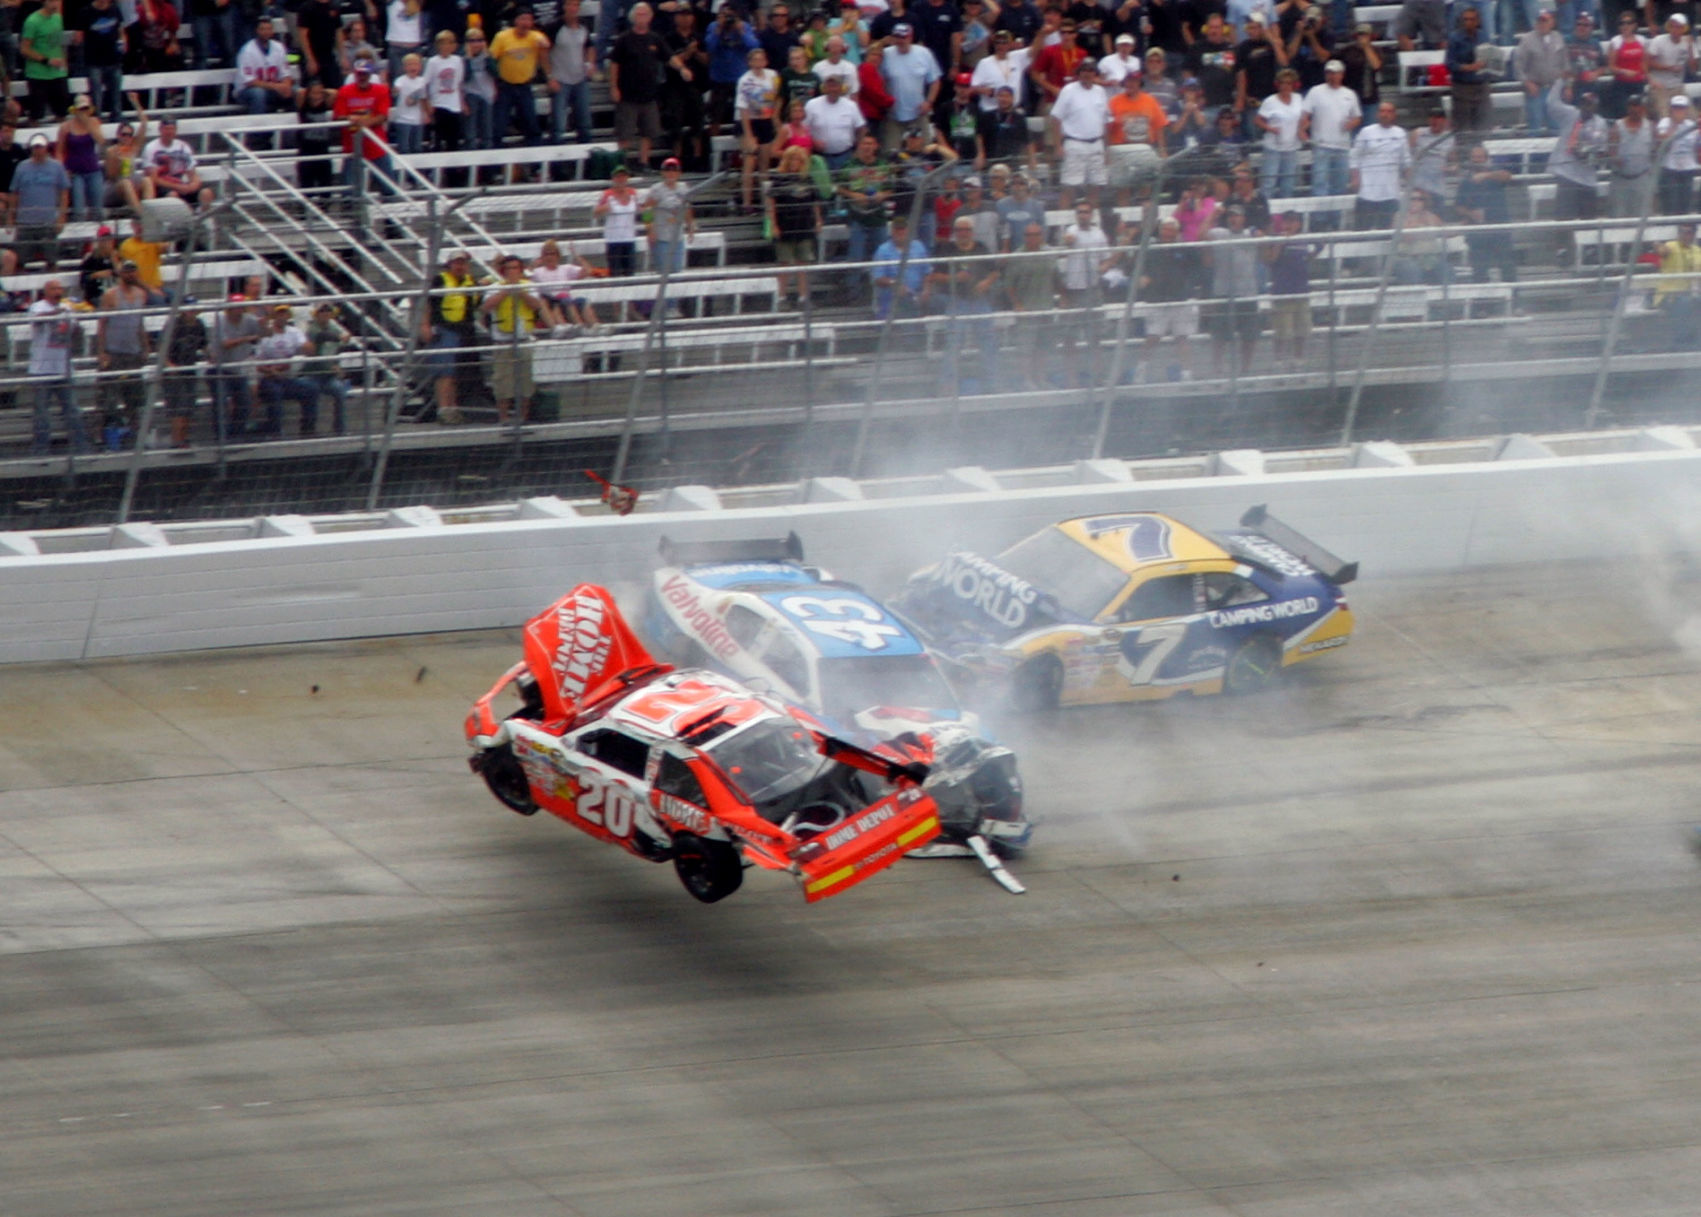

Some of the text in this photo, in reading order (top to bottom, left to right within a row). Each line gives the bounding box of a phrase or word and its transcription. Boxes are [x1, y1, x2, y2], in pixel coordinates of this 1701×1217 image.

[1082, 513, 1174, 564] 7
[551, 606, 577, 676] DEPOT
[660, 574, 738, 660] Valvoline
[781, 596, 900, 650] 43
[1209, 596, 1319, 629] CAMPING WORLD
[560, 595, 604, 704] HOME
[591, 634, 613, 676] THE
[1130, 622, 1190, 686] 7
[575, 768, 637, 838] 20
